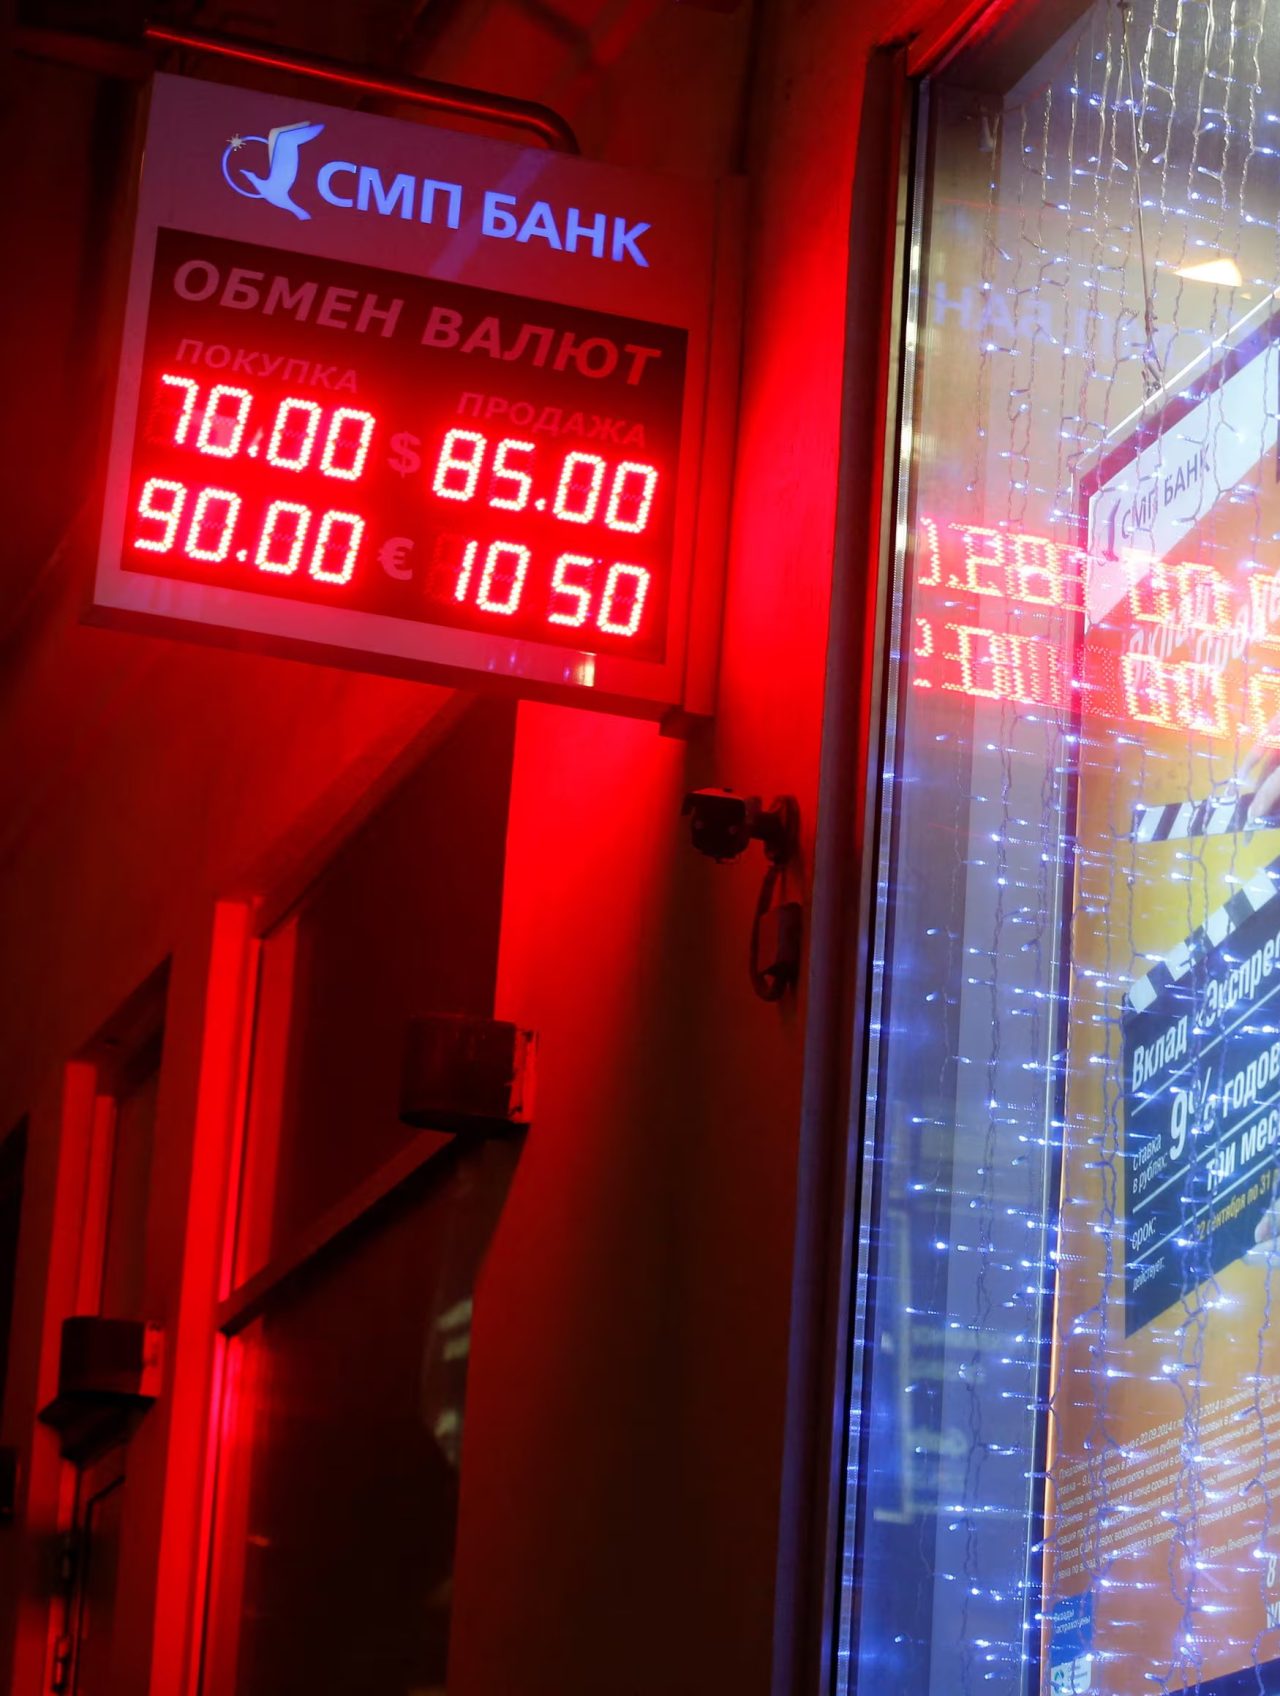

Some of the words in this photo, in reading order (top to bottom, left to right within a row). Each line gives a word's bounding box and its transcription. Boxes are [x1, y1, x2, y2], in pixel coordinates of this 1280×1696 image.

[317, 160, 462, 229] СМП
[482, 190, 652, 267] БАНК
[173, 259, 405, 338] ОБМЕН
[420, 305, 662, 386] ВАЛЮТ
[174, 337, 360, 395] ПОКУПКА
[161, 373, 377, 482] 70.00
[432, 427, 659, 534] 85.00
[457, 391, 649, 449] ПРОДАЖА
[1164, 443, 1211, 507] БАНК
[134, 476, 366, 586] 90.00
[1132, 1015, 1188, 1092] Вклад
[1266, 1555, 1277, 1588] 8
